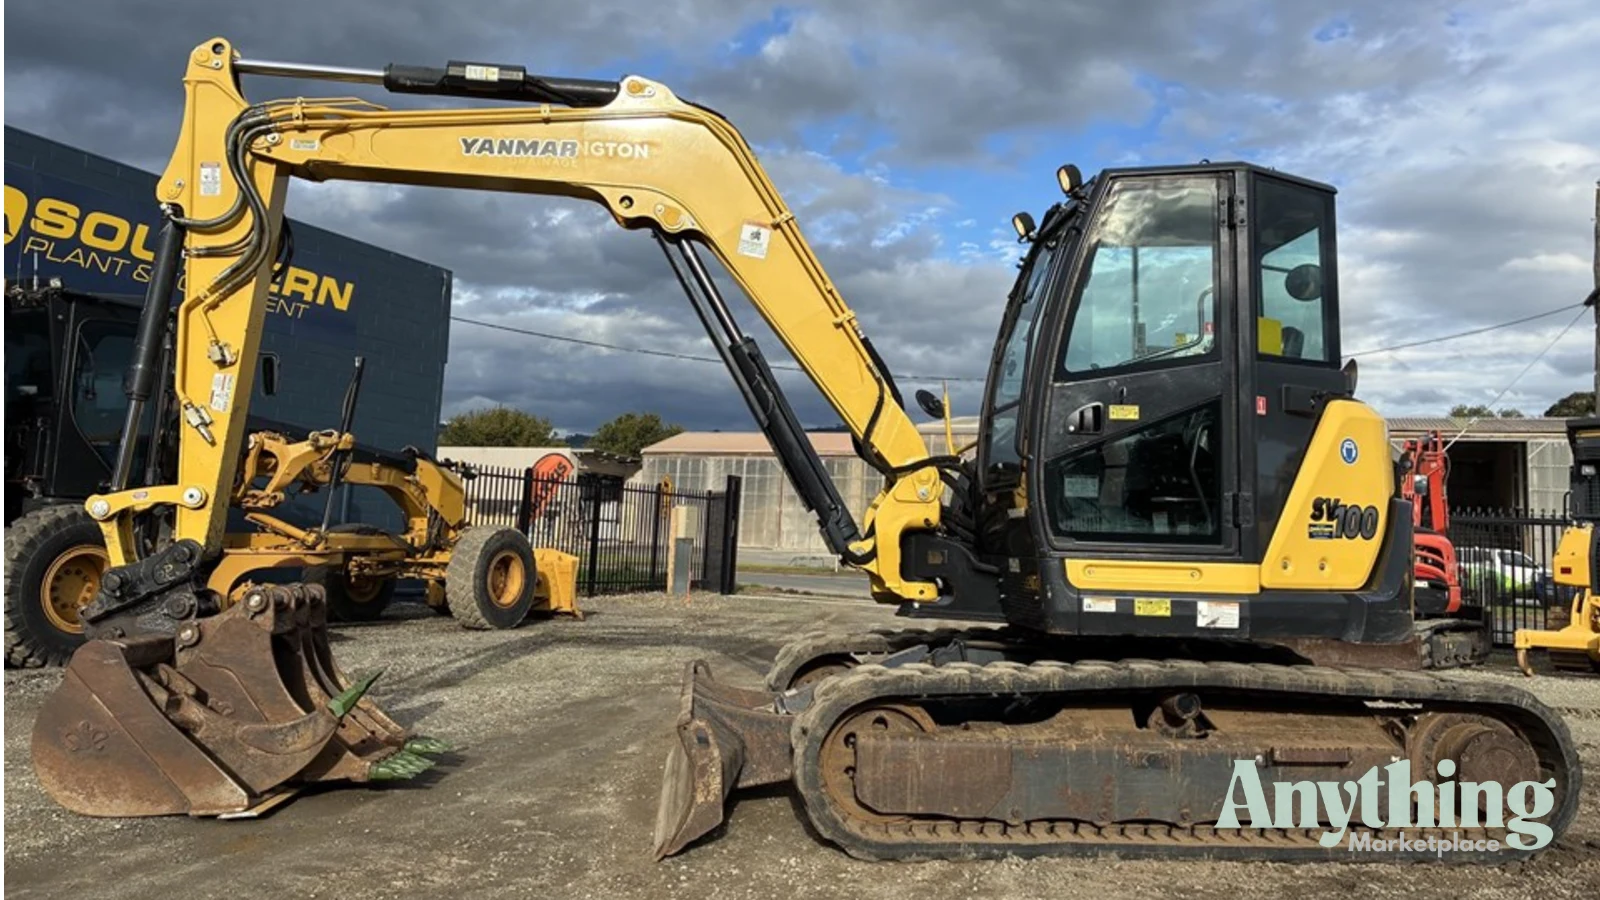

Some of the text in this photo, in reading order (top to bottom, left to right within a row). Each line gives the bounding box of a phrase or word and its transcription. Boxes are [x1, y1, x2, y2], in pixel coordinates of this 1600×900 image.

[460, 137, 578, 158] YANMAR
[24, 236, 153, 283] PLANT &
